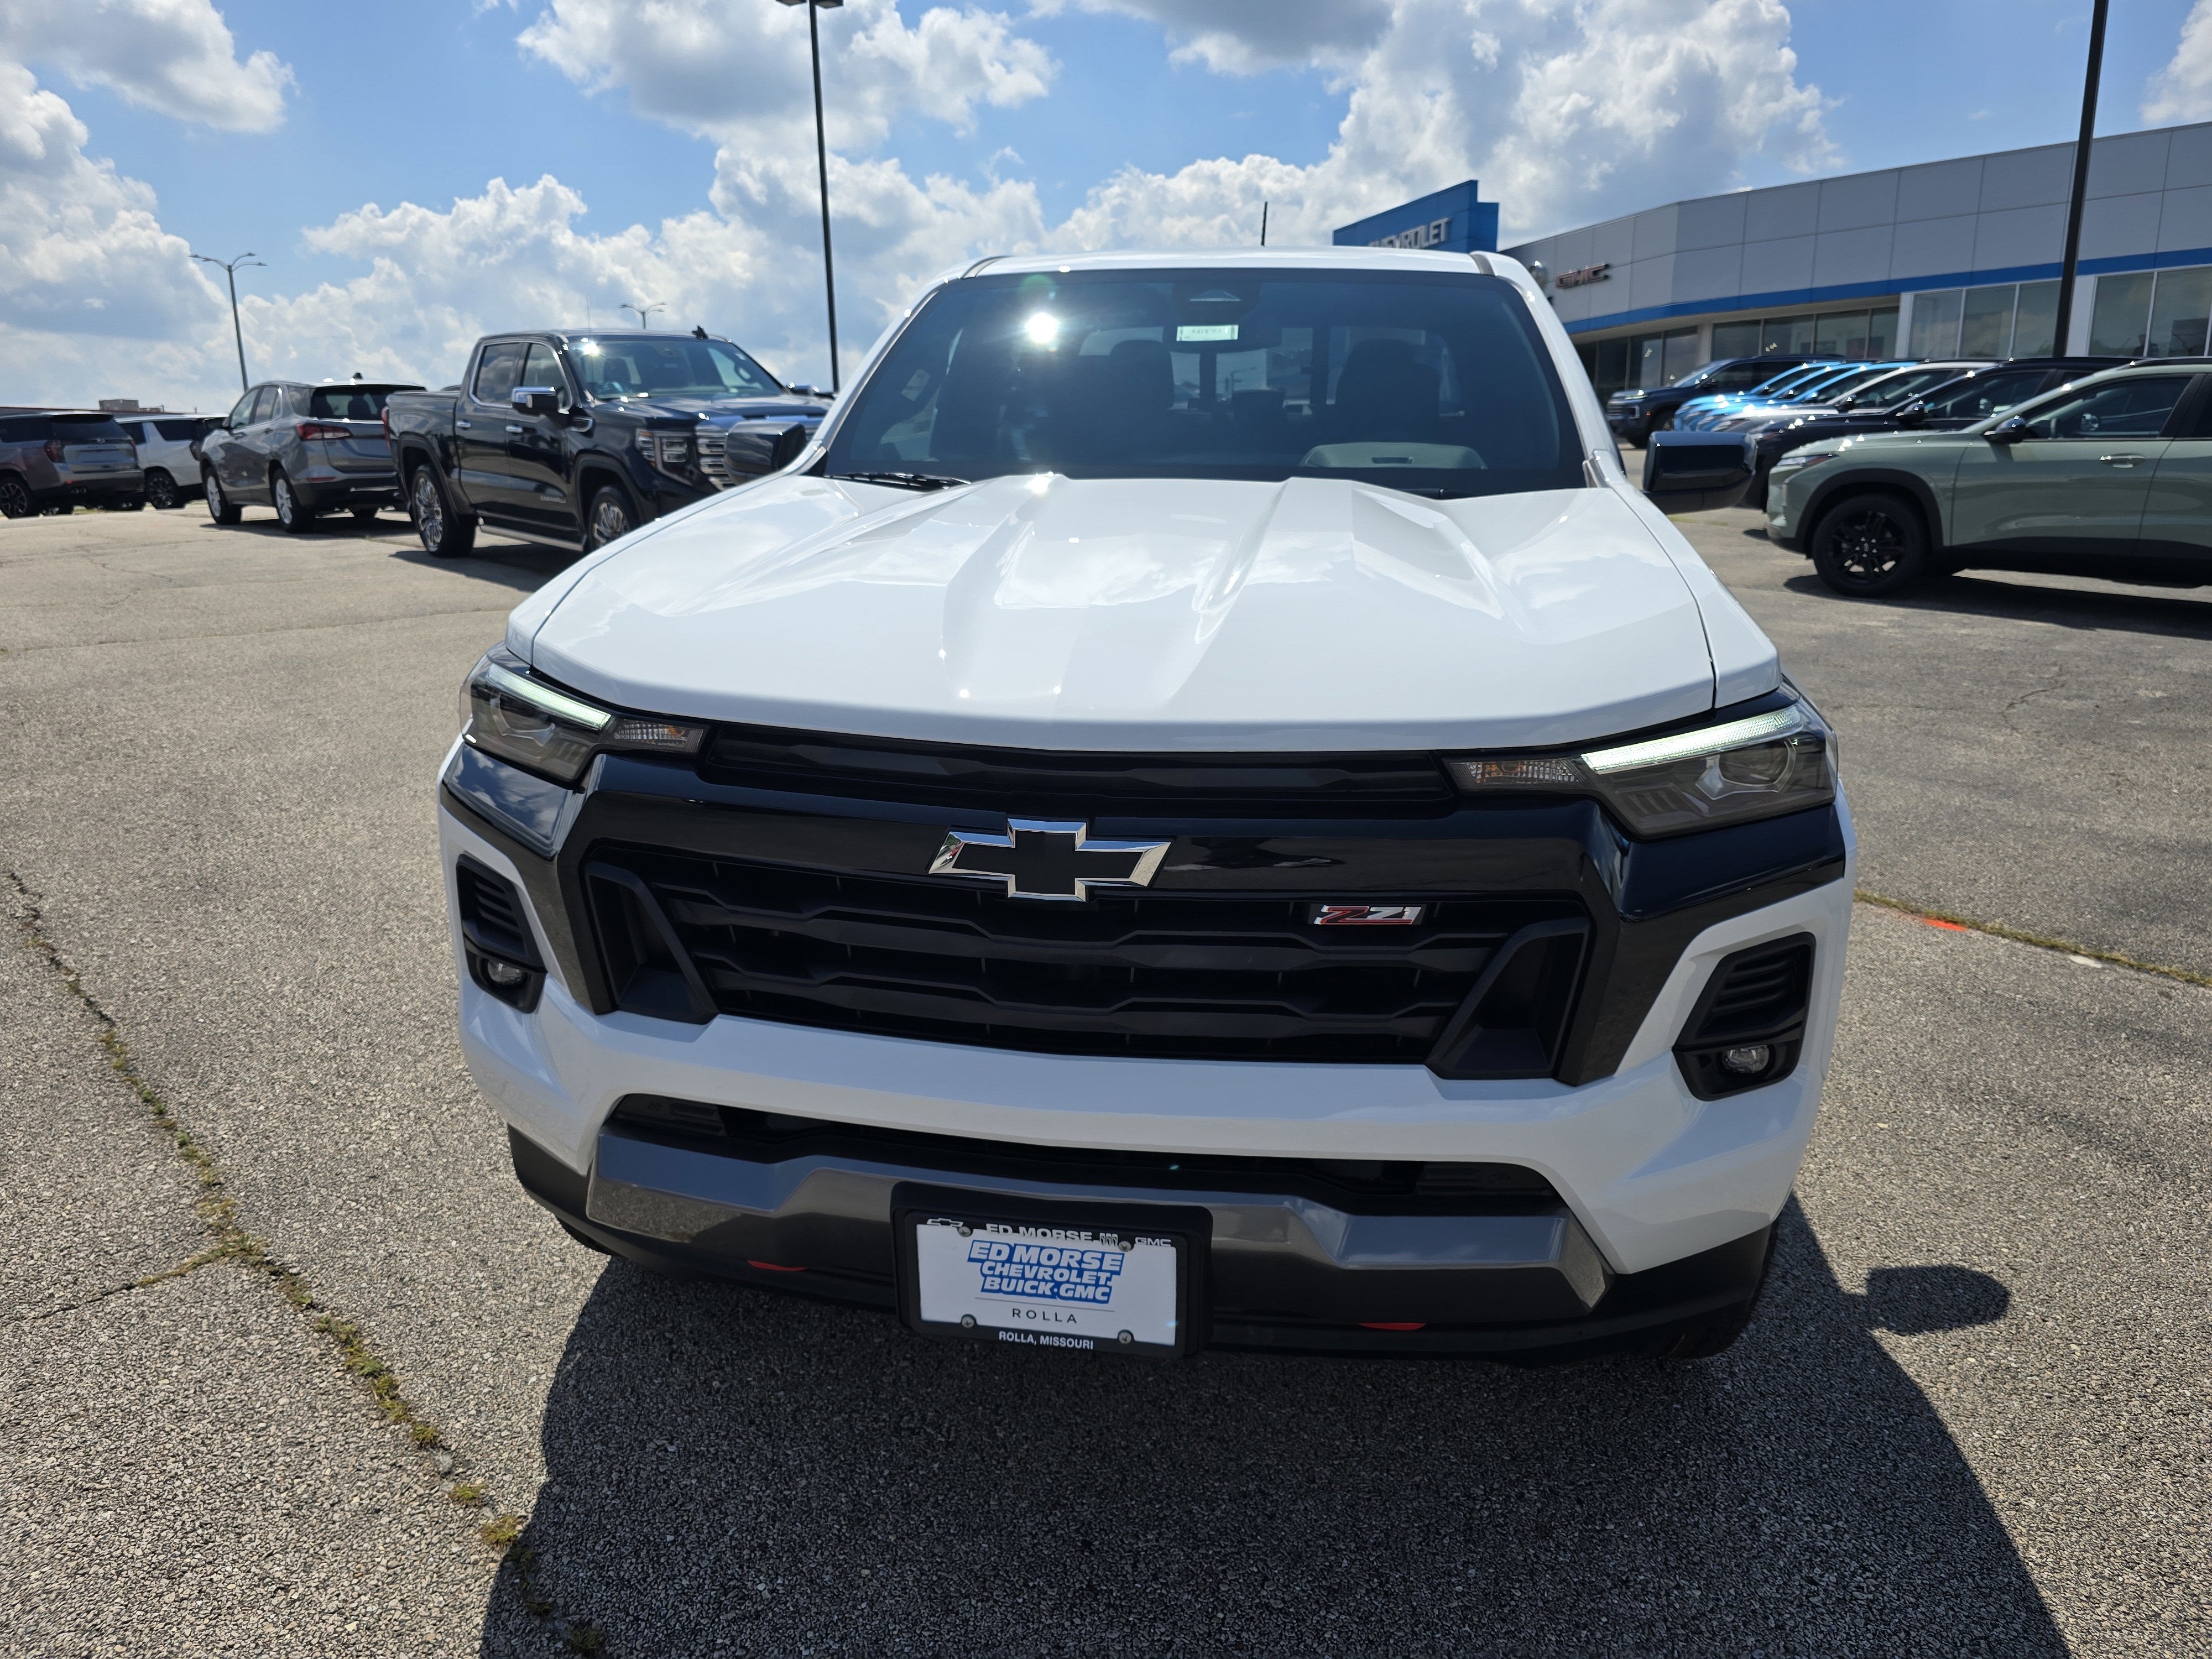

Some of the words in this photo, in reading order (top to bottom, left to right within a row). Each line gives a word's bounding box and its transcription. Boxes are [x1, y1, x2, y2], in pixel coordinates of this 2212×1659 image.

[1555, 263, 1606, 289] GMC
[1314, 905, 1421, 925] Z71
[986, 1223, 1013, 1235] ED
[1019, 1226, 1093, 1243] MORSE
[1135, 1237, 1171, 1247] GMC
[969, 1241, 1010, 1261] ED
[1012, 1245, 1123, 1271] MORSE
[982, 1261, 1111, 1285] CHEVROLET
[1012, 1308, 1077, 1324] ROLLA
[999, 1331, 1037, 1345] ROLLA,
[1040, 1335, 1093, 1350] MISSOURI
